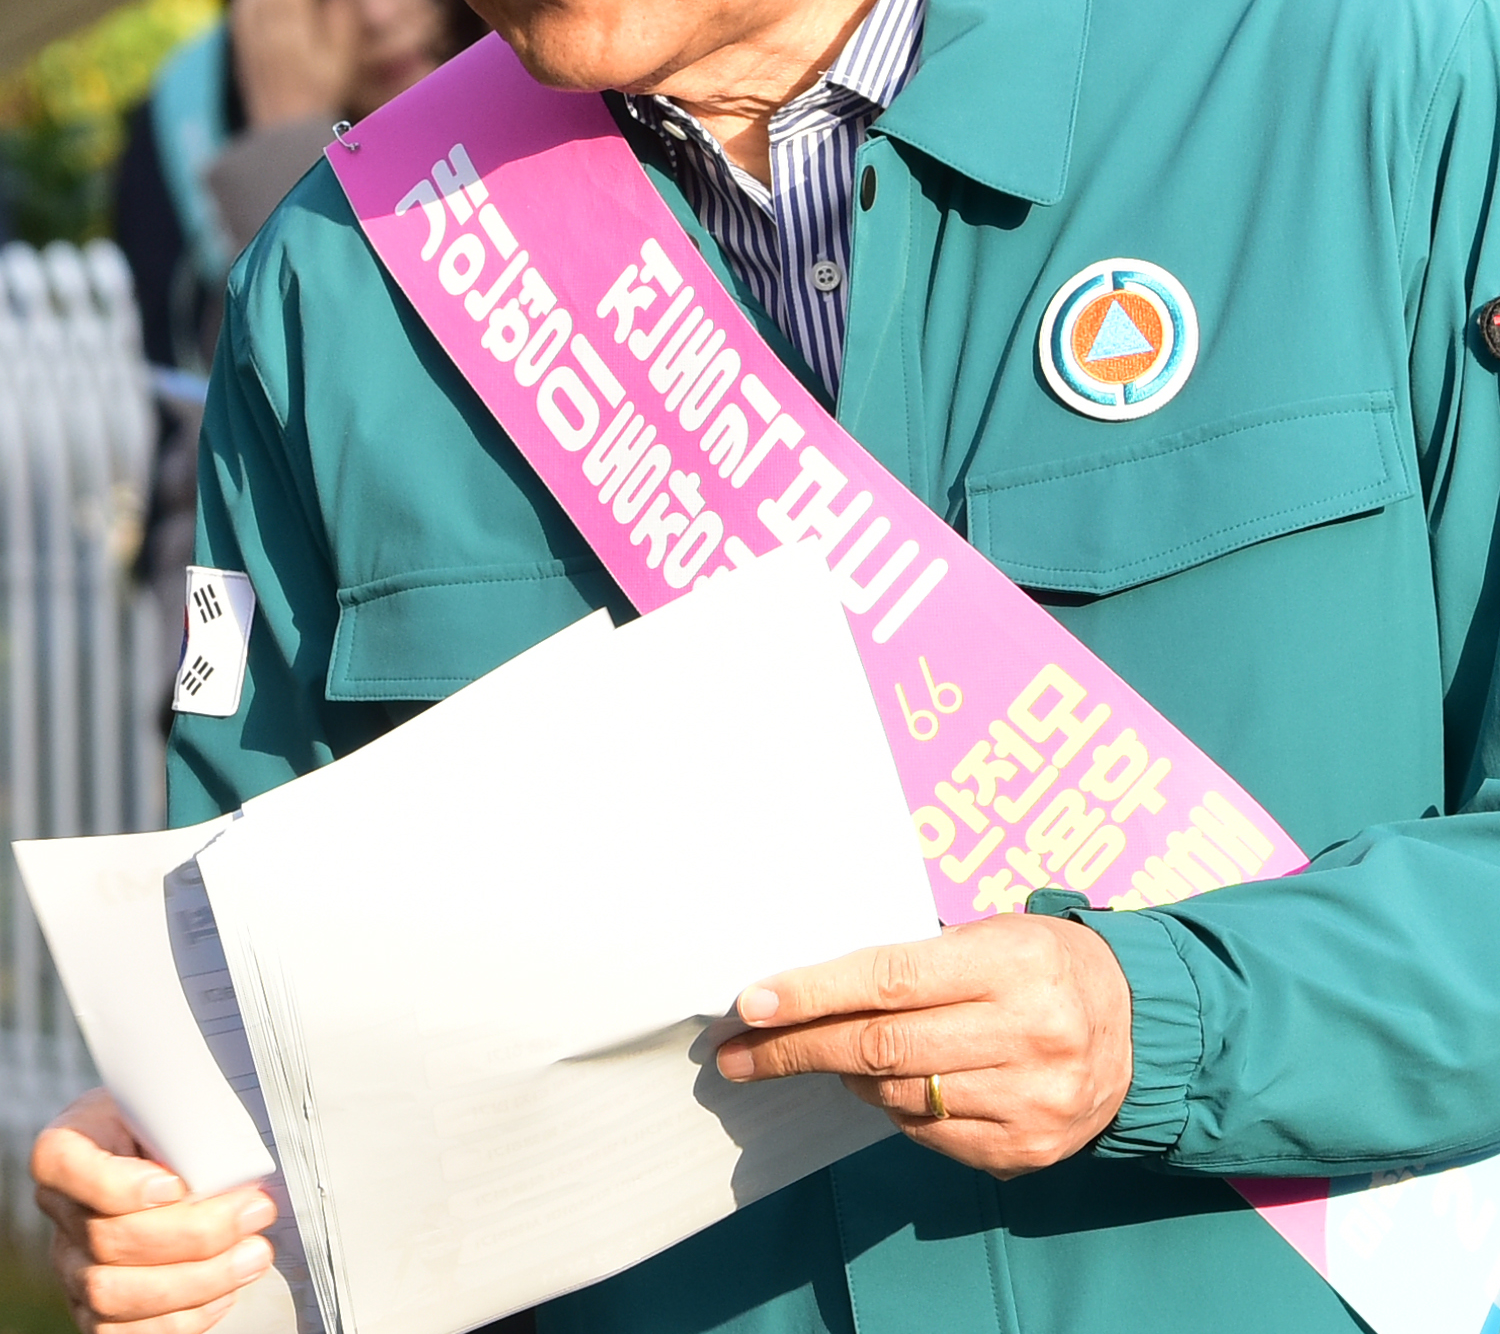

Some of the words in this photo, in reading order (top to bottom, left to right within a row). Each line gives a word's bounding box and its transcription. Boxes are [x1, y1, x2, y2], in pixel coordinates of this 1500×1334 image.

[395, 142, 762, 591] 개인형이동장
[598, 238, 949, 645] 전동킥보드
[912, 663, 1112, 883] 안전모
